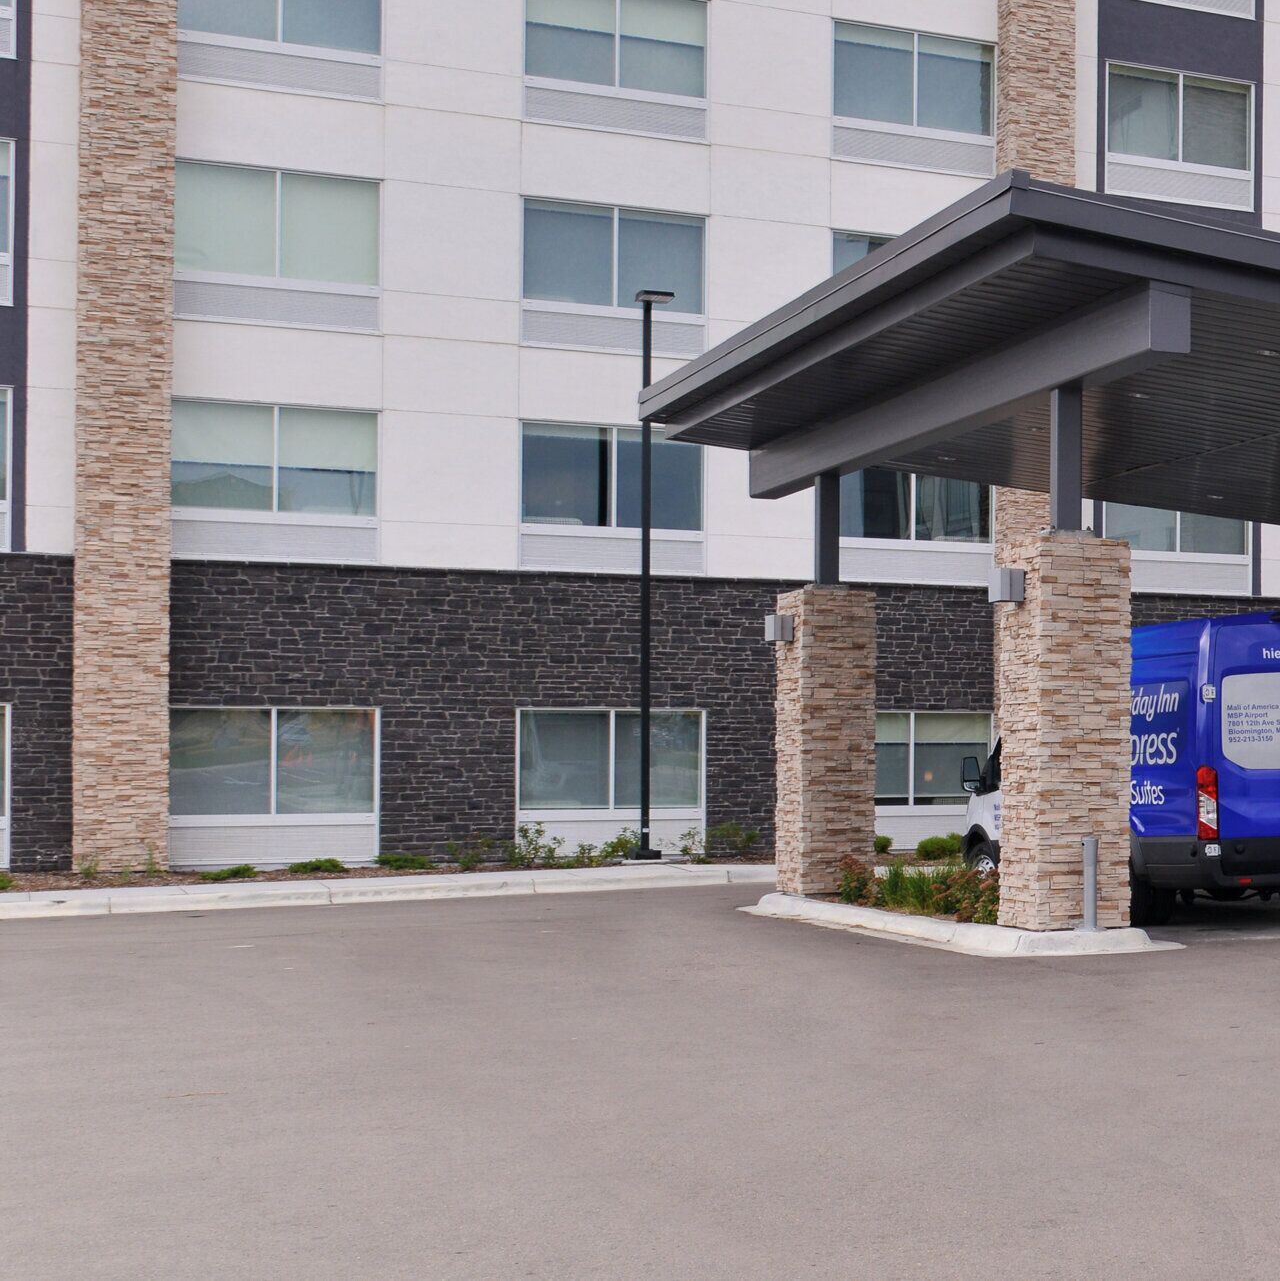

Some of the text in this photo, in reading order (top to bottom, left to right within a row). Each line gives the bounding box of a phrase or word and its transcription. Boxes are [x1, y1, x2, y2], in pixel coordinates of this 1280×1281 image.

[1130, 683, 1179, 722] iday Inn
[1130, 731, 1178, 765] press
[1130, 779, 1165, 805] Suites
